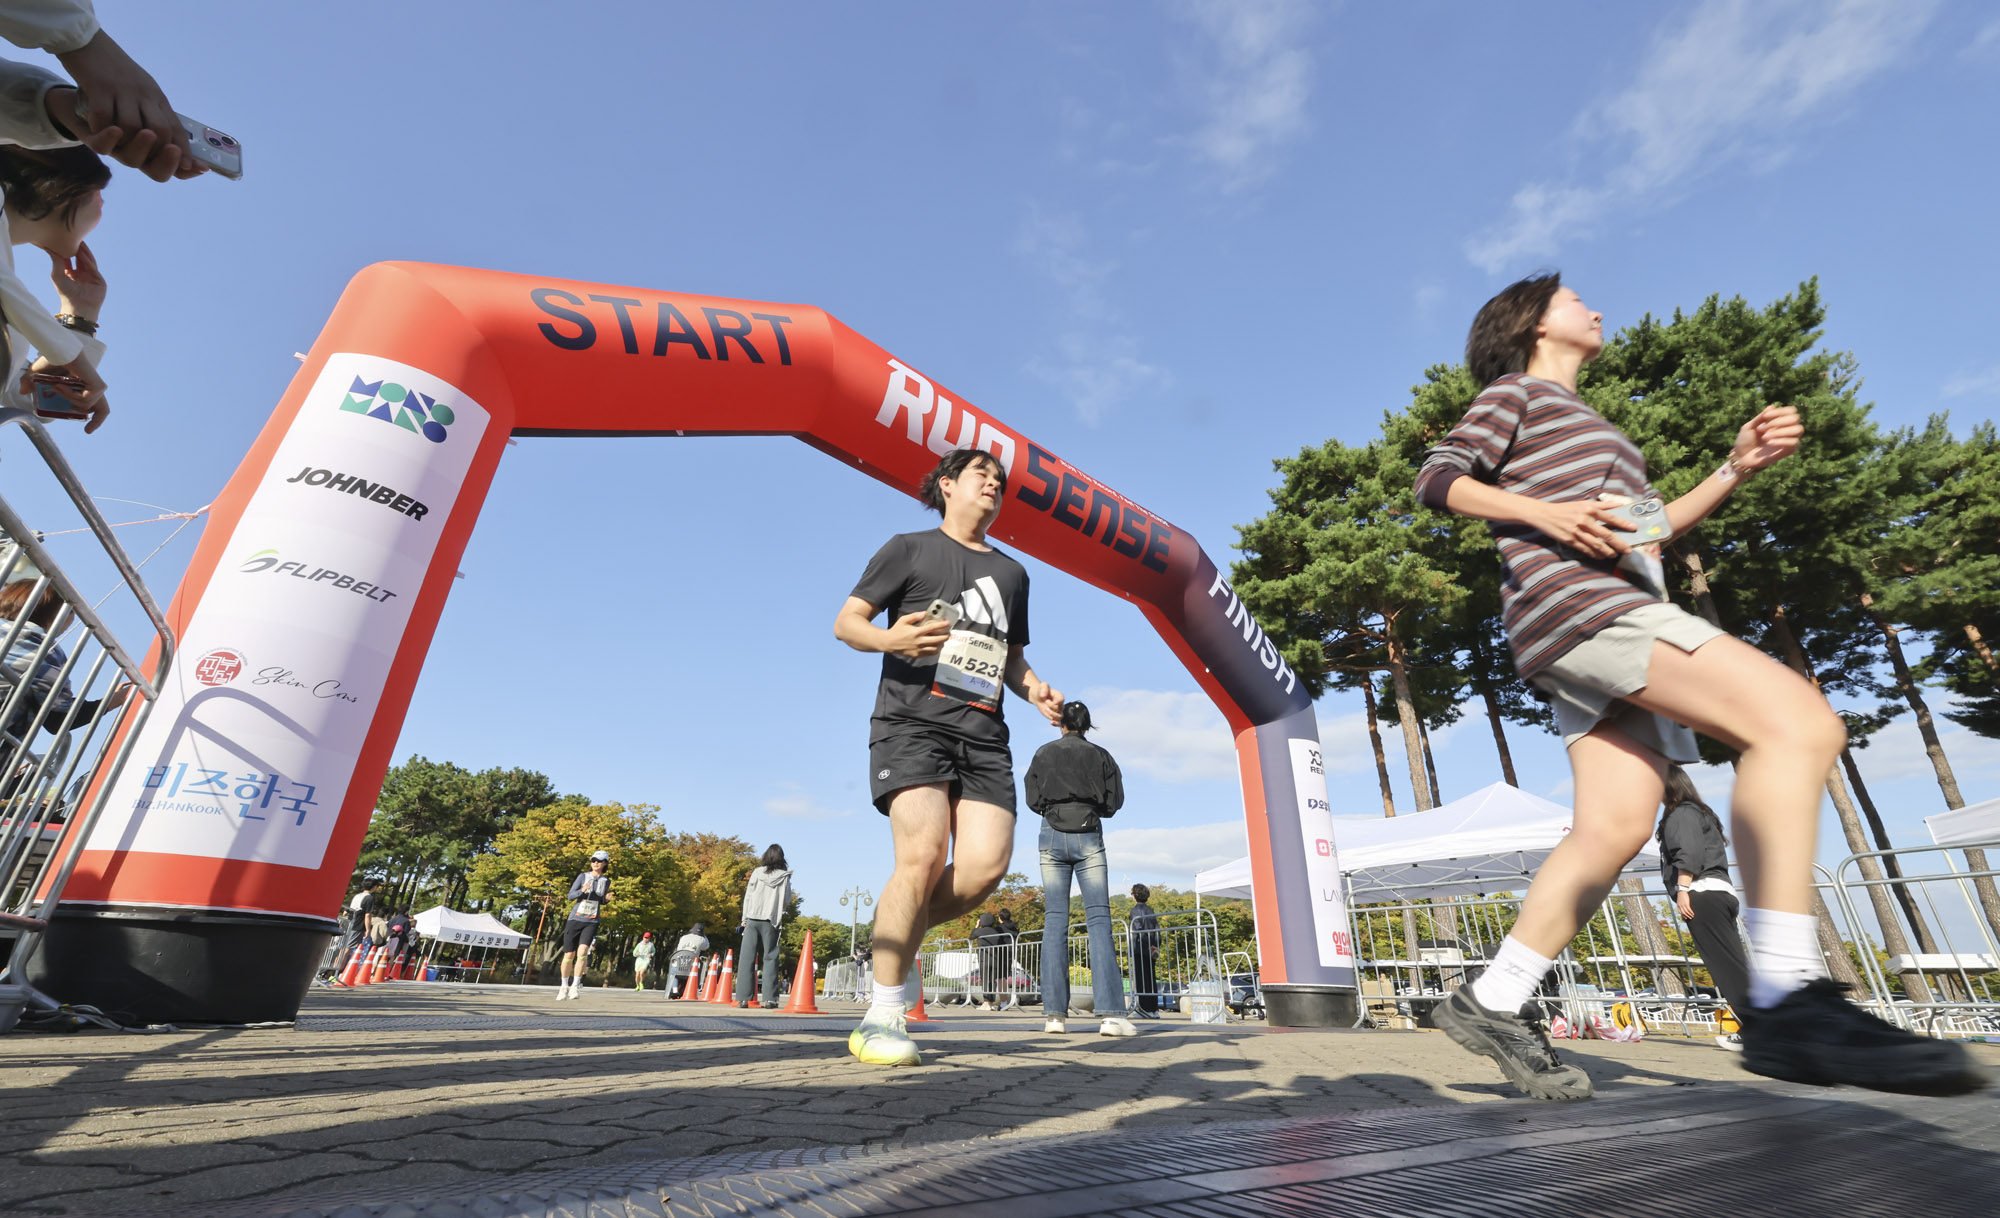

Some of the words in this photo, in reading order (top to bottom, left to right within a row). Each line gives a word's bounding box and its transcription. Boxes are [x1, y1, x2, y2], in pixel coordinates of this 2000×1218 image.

[530, 287, 793, 366] START
[286, 466, 429, 522] JOHNBER
[274, 561, 398, 603] FLIPBELT
[950, 654, 963, 666] M
[1207, 569, 1296, 696] FINISH
[252, 666, 309, 689] Skin
[312, 679, 358, 703] Cons
[141, 762, 318, 826] 비즈한국
